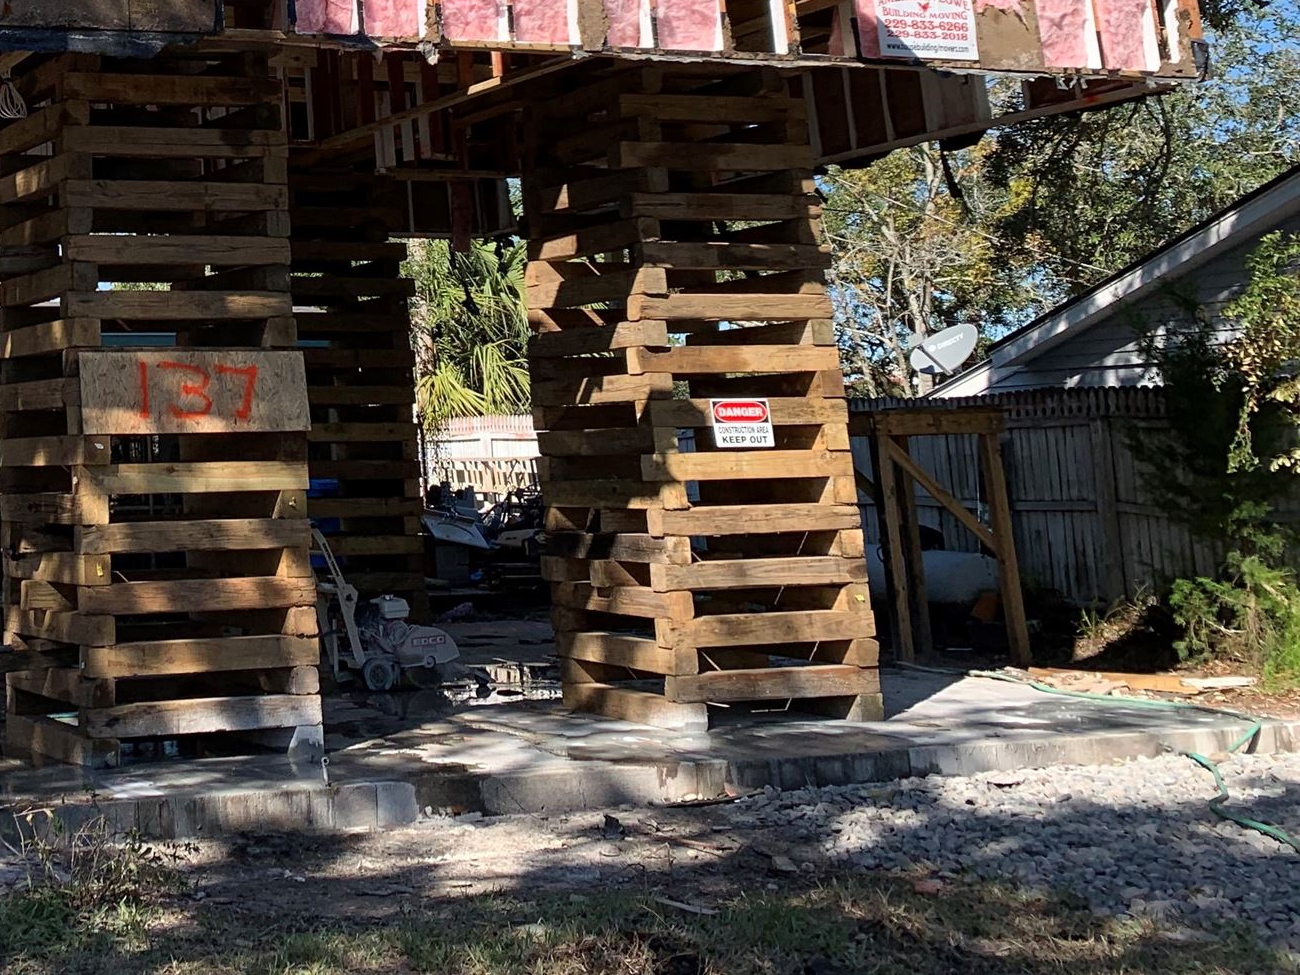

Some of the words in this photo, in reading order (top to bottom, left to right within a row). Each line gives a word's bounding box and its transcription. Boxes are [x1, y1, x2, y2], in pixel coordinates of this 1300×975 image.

[882, 7, 925, 18] BUILDING
[929, 11, 967, 20] MOVING
[884, 19, 968, 31] 229-833-6266
[887, 29, 967, 40] 229-833-2018
[138, 359, 257, 420] 137
[718, 406, 763, 416] DANGER
[412, 636, 444, 645] EDCO
